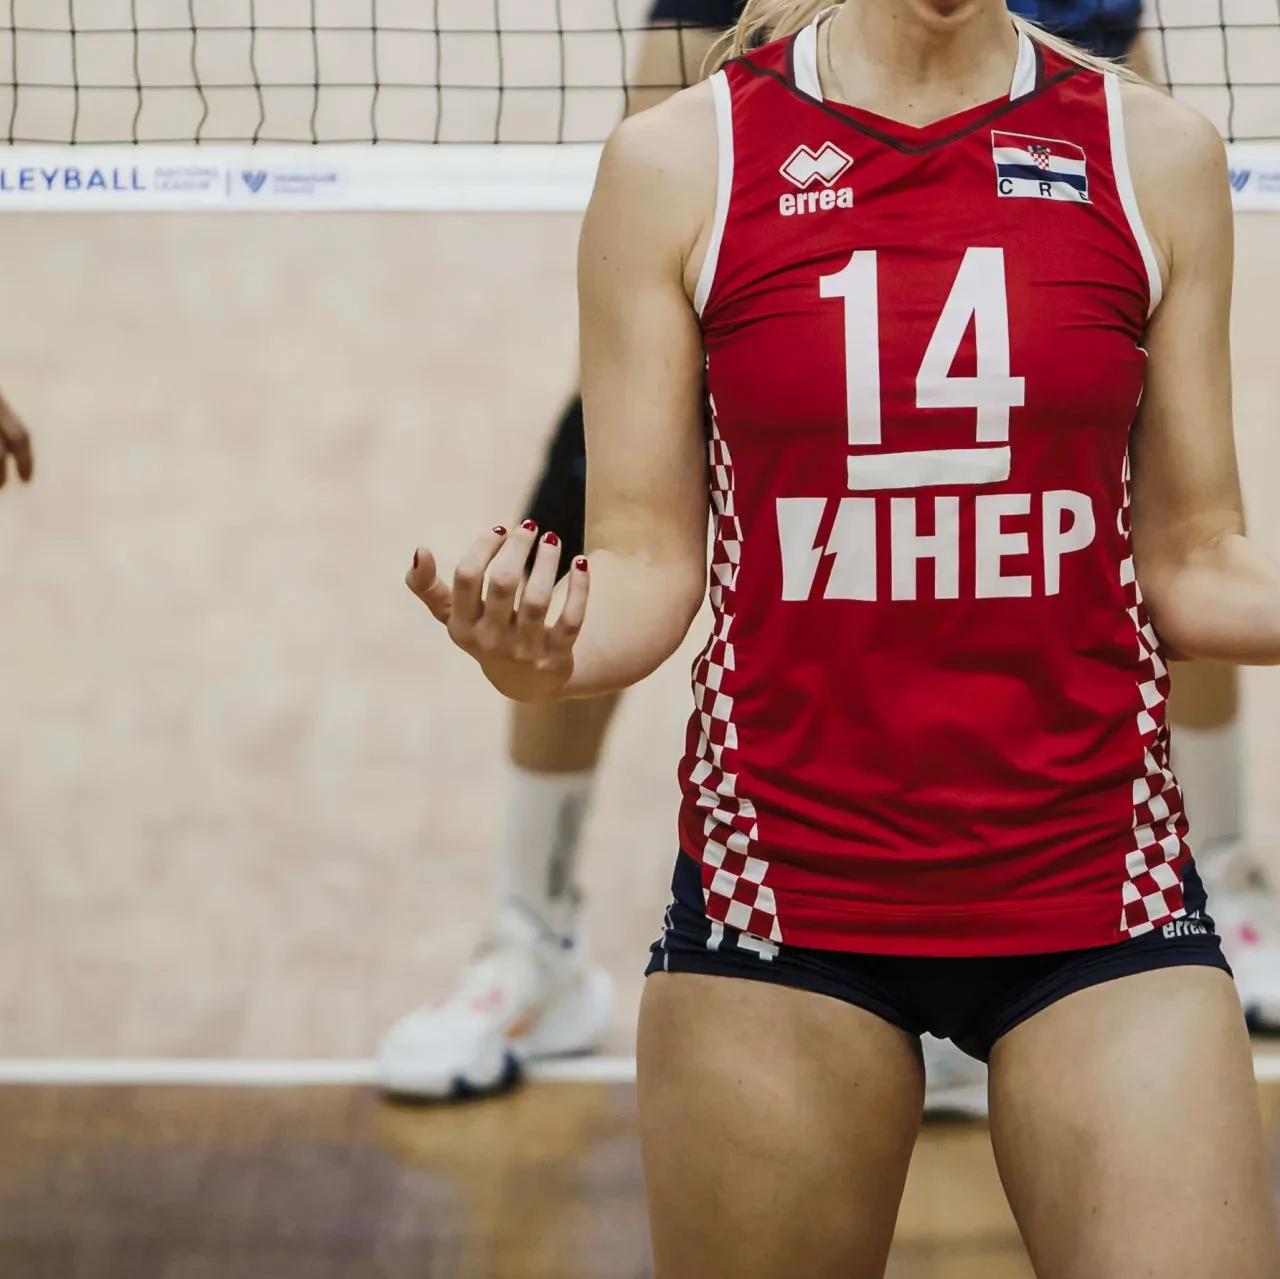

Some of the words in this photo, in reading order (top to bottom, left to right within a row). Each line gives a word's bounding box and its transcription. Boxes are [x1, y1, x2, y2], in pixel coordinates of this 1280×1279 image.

[779, 187, 854, 216] errea
[819, 247, 1025, 445] 14
[890, 489, 1096, 601] HEP
